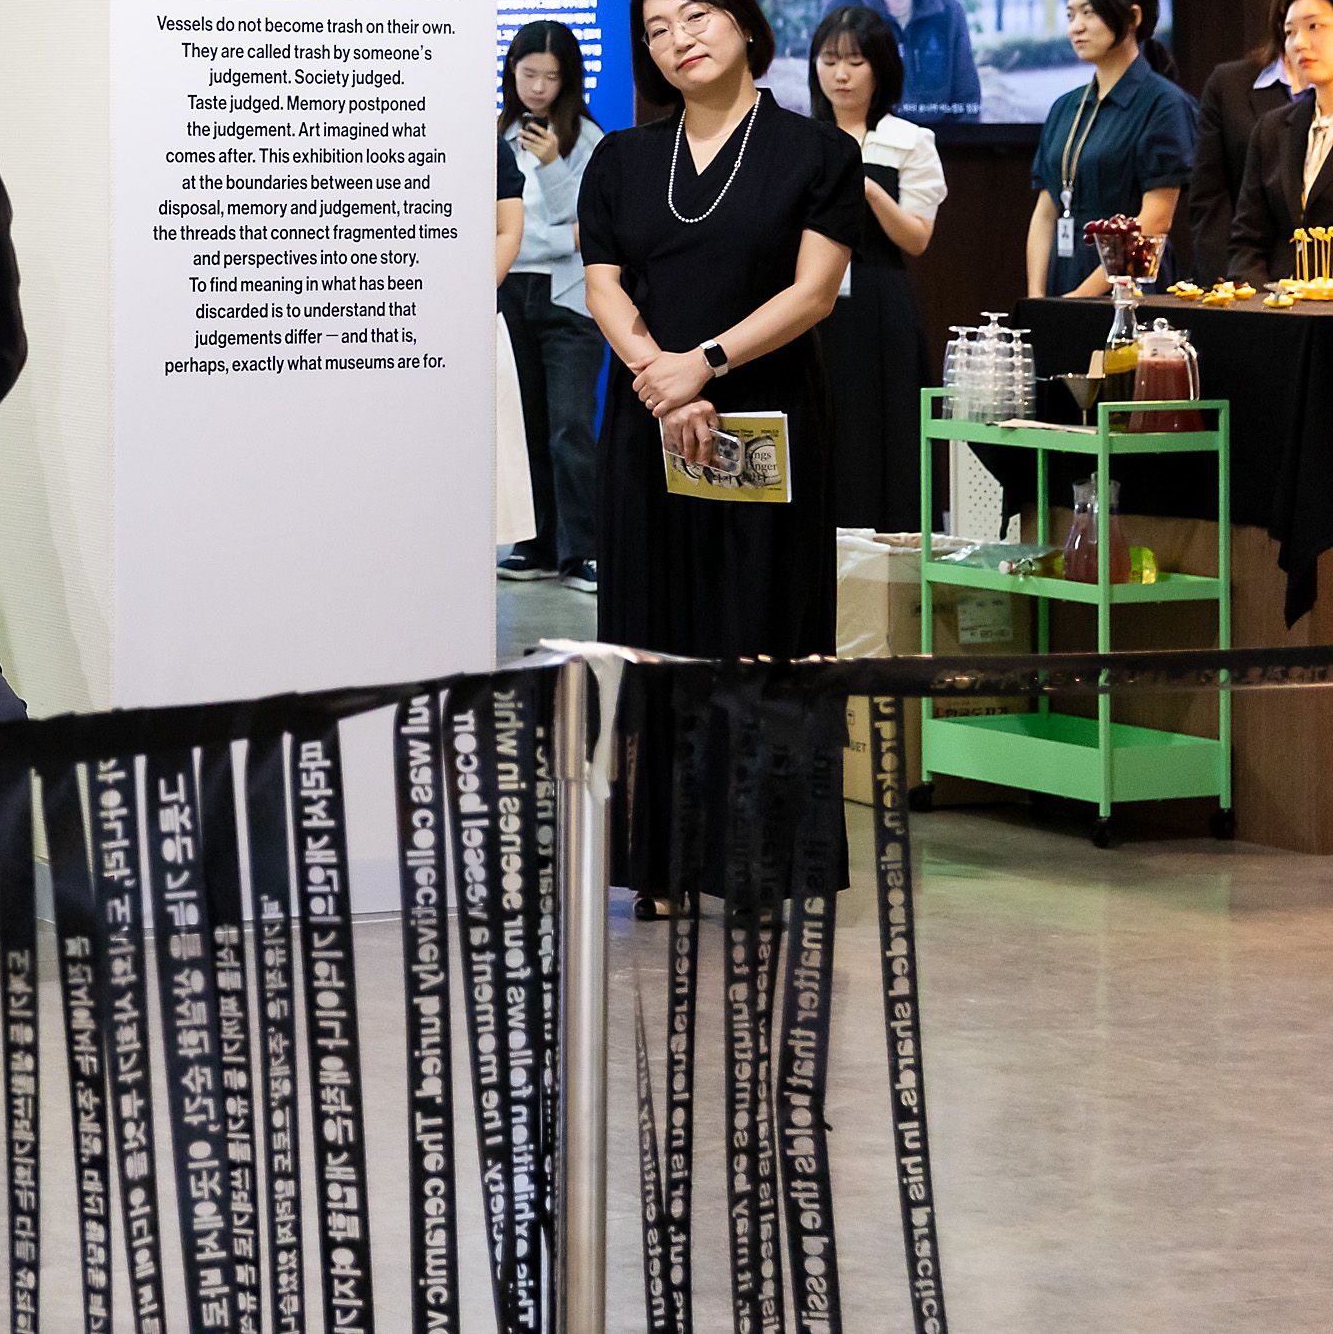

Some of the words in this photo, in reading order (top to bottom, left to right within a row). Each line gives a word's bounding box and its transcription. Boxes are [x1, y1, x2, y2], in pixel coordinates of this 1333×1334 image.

[156, 15, 213, 32] Vessels
[216, 16, 235, 32] do
[238, 17, 262, 32] not
[265, 16, 324, 33] become
[326, 18, 363, 34] trash
[366, 22, 384, 34] on
[387, 18, 420, 34] their
[422, 22, 455, 35] own.
[181, 42, 218, 62] They
[220, 46, 245, 59] are
[247, 43, 291, 59] called
[293, 44, 331, 60] trash
[333, 44, 351, 63] by
[353, 44, 432, 61] someone’s
[208, 67, 292, 87] judgement.
[294, 68, 350, 88] Society
[351, 69, 405, 89] judged.
[187, 94, 227, 110] Taste
[229, 94, 284, 114] judged.
[287, 95, 346, 114] Memory
[348, 96, 426, 115] postponed
[186, 120, 211, 137] the
[212, 121, 296, 140] judgement.
[298, 121, 321, 137] Art
[323, 121, 389, 141] imagined
[391, 121, 427, 138] what
[165, 151, 216, 164] comes
[218, 147, 256, 164] after.
[258, 147, 290, 164] This
[292, 147, 363, 164] exhibition
[366, 148, 405, 164] looks
[407, 152, 446, 167] again
[181, 175, 197, 190] at
[198, 174, 223, 190] the
[226, 174, 308, 190] boundaries
[310, 174, 373, 190] between
[376, 178, 402, 190] use
[404, 174, 430, 190] and
[158, 199, 224, 219] disposal,
[227, 203, 288, 218] memory
[290, 199, 317, 215] and
[318, 199, 400, 218] judgement,
[402, 199, 453, 218] tracing
[152, 224, 177, 241] the
[179, 224, 237, 241] threads
[238, 224, 268, 241] that
[270, 225, 330, 240] connect
[332, 224, 416, 243] fragmented
[418, 223, 458, 239] times
[193, 250, 221, 266] and
[223, 249, 318, 269] perspectives
[320, 249, 348, 265] into
[350, 252, 378, 265] one
[380, 249, 420, 268] story.
[188, 276, 207, 293] To
[209, 276, 238, 293] find
[240, 275, 303, 295] meaning
[306, 275, 319, 292] in
[321, 275, 357, 291] what
[359, 275, 385, 291] has
[387, 275, 423, 291] been
[195, 302, 269, 319] discarded
[271, 302, 284, 318] is
[285, 303, 301, 318] to
[303, 301, 386, 318] understand
[388, 301, 417, 317] that
[194, 329, 282, 349] judgements
[284, 328, 323, 345] differ
[341, 327, 368, 344] and
[370, 327, 399, 343] that
[401, 327, 417, 346] is,
[164, 356, 229, 377] perhaps,
[231, 355, 285, 375] exactly
[287, 355, 323, 371] what
[325, 357, 395, 370] museums
[397, 357, 421, 369] are
[422, 353, 446, 369] for.
